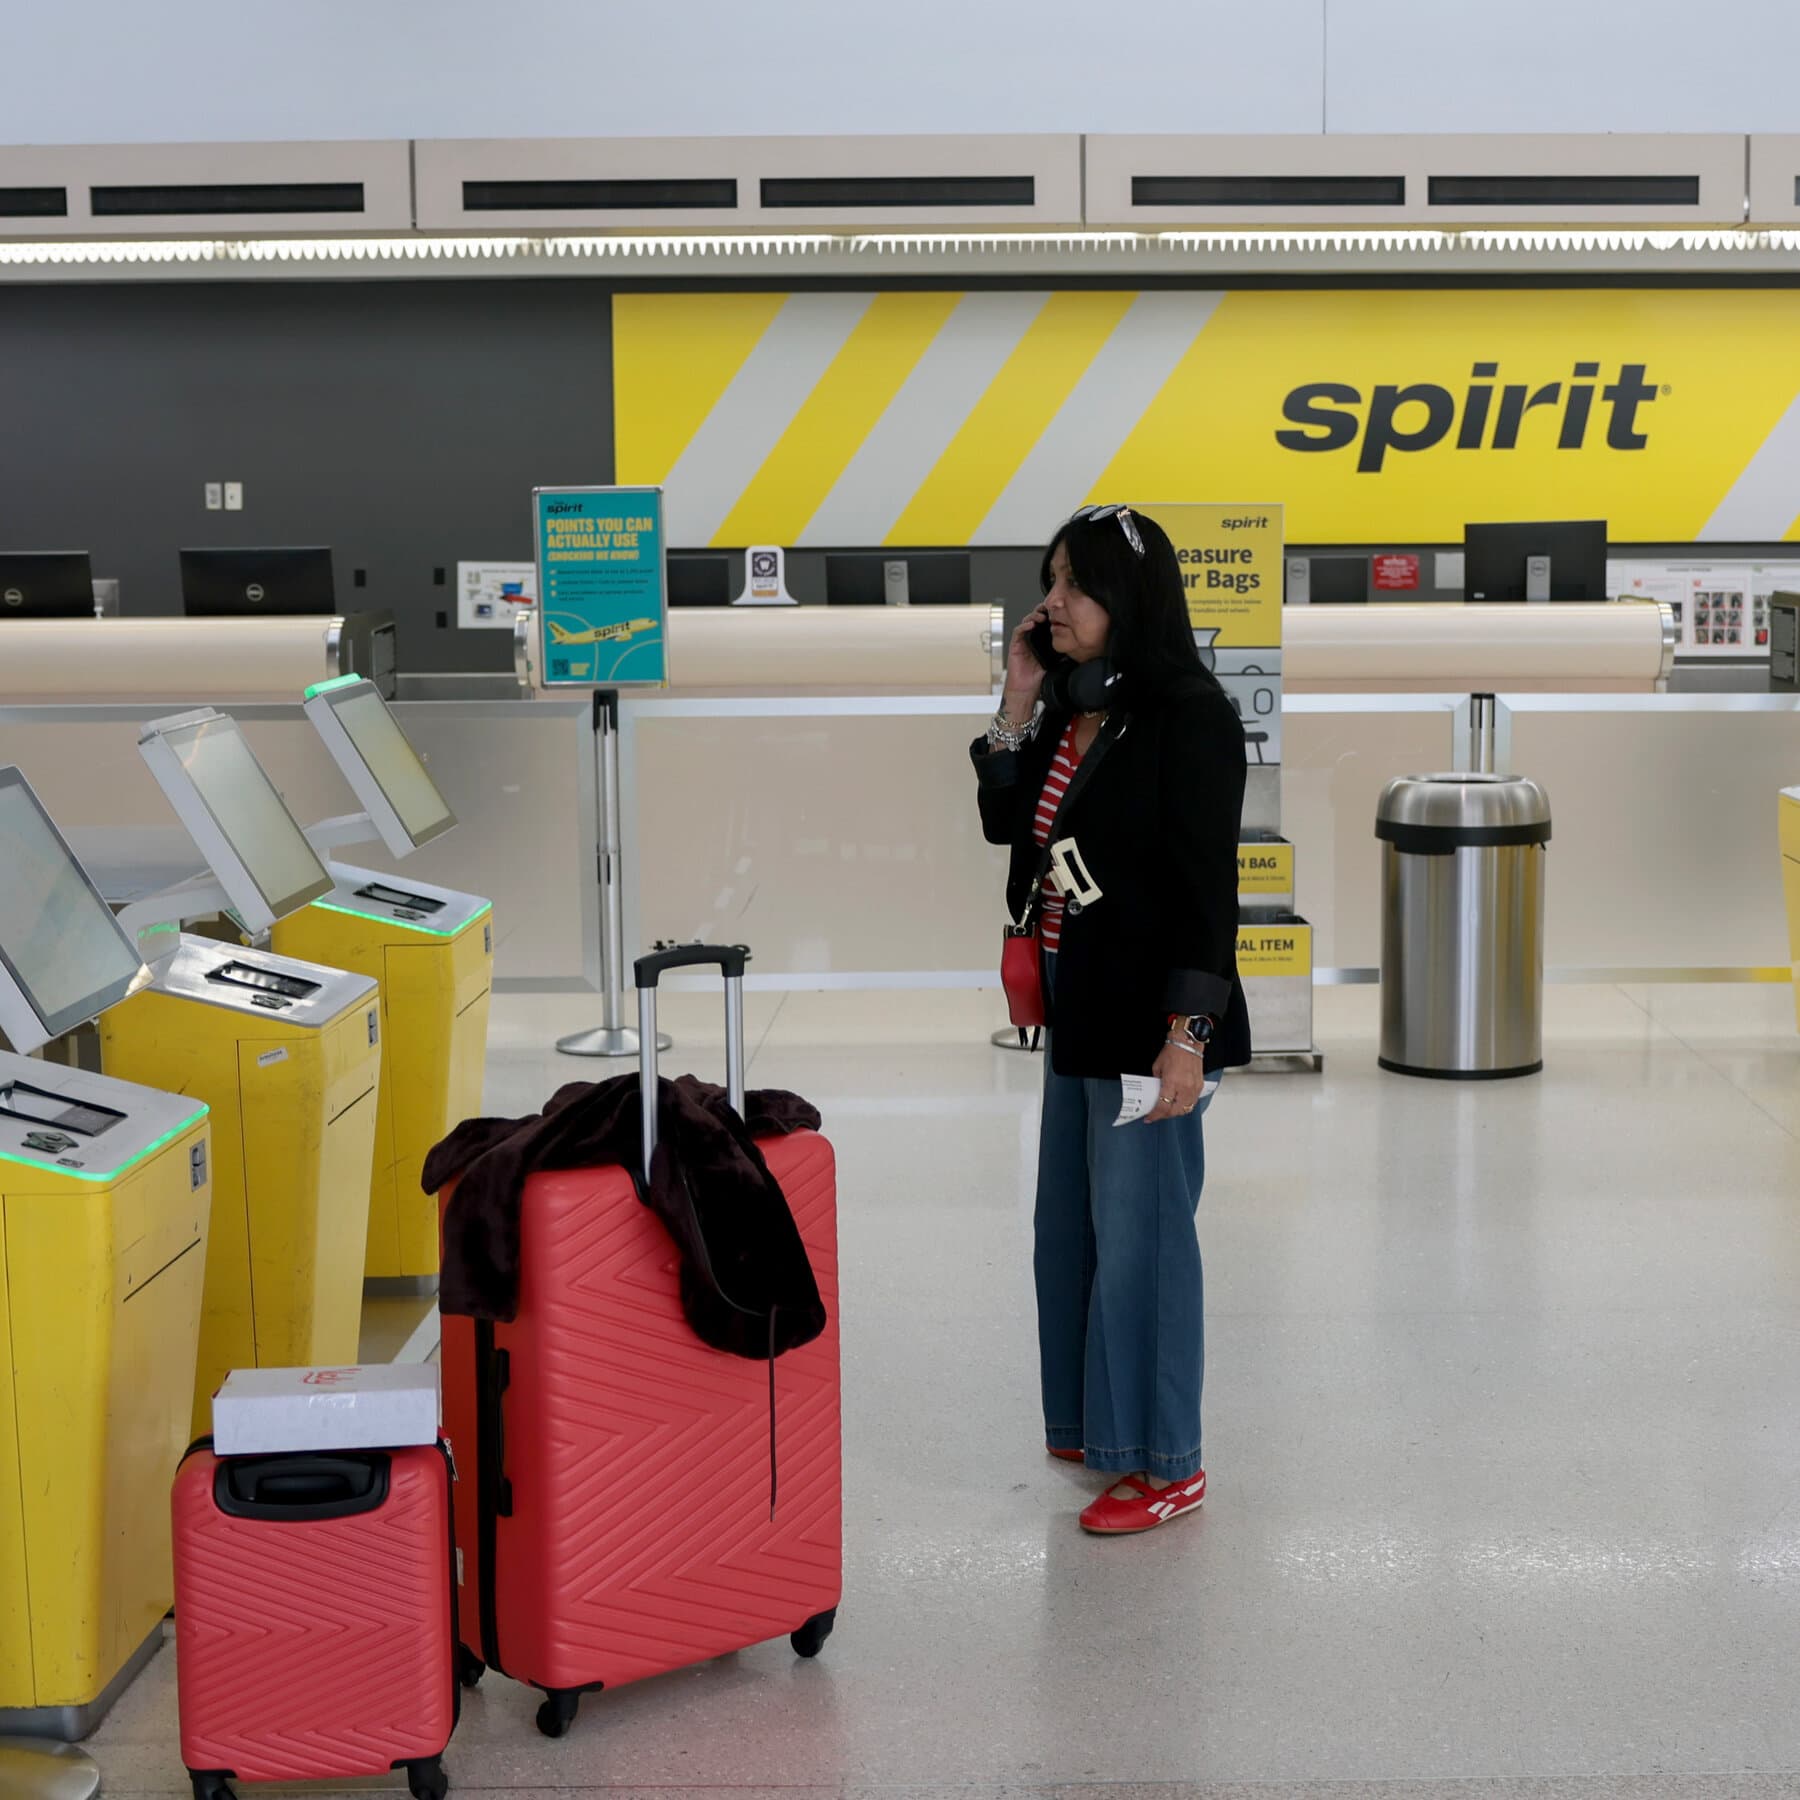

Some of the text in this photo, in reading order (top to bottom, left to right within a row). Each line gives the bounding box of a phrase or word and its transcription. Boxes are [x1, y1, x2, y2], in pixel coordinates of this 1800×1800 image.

[547, 503, 584, 515] spirit
[546, 517, 653, 532] POINTS YOU CAN
[1221, 516, 1269, 530] spirit
[547, 533, 639, 548] ACTUALLY USE
[1177, 548, 1253, 564] easure
[1206, 569, 1261, 594] Bags
[593, 621, 630, 637] spirit
[1249, 857, 1277, 869] BAG
[1260, 939, 1294, 951] ITEM
